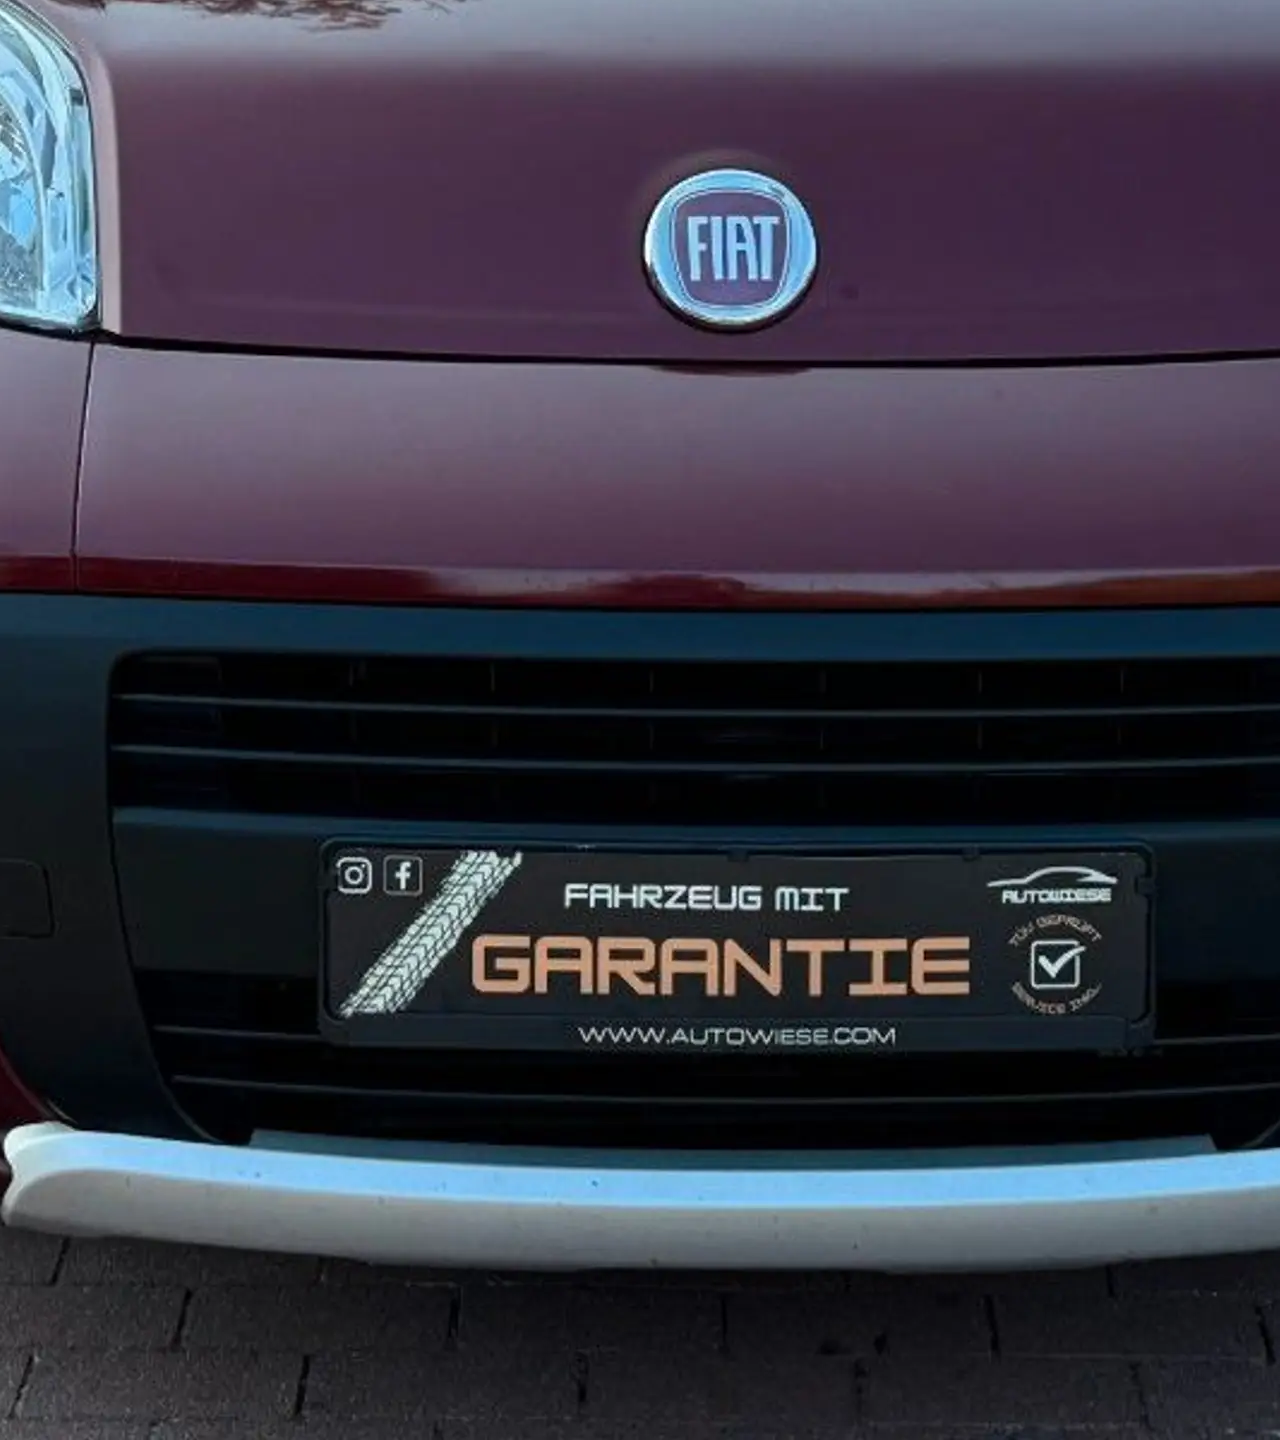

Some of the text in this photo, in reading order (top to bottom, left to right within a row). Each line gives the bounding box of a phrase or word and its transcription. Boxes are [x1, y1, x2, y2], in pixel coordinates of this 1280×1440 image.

[687, 215, 780, 282] FIAT
[564, 883, 850, 912] FAHRZEUG MIT
[1001, 888, 1112, 904] AUTOWIESE
[471, 934, 971, 997] GARANTIE
[578, 1026, 896, 1046] WWW.AUTOWIESE.COM
